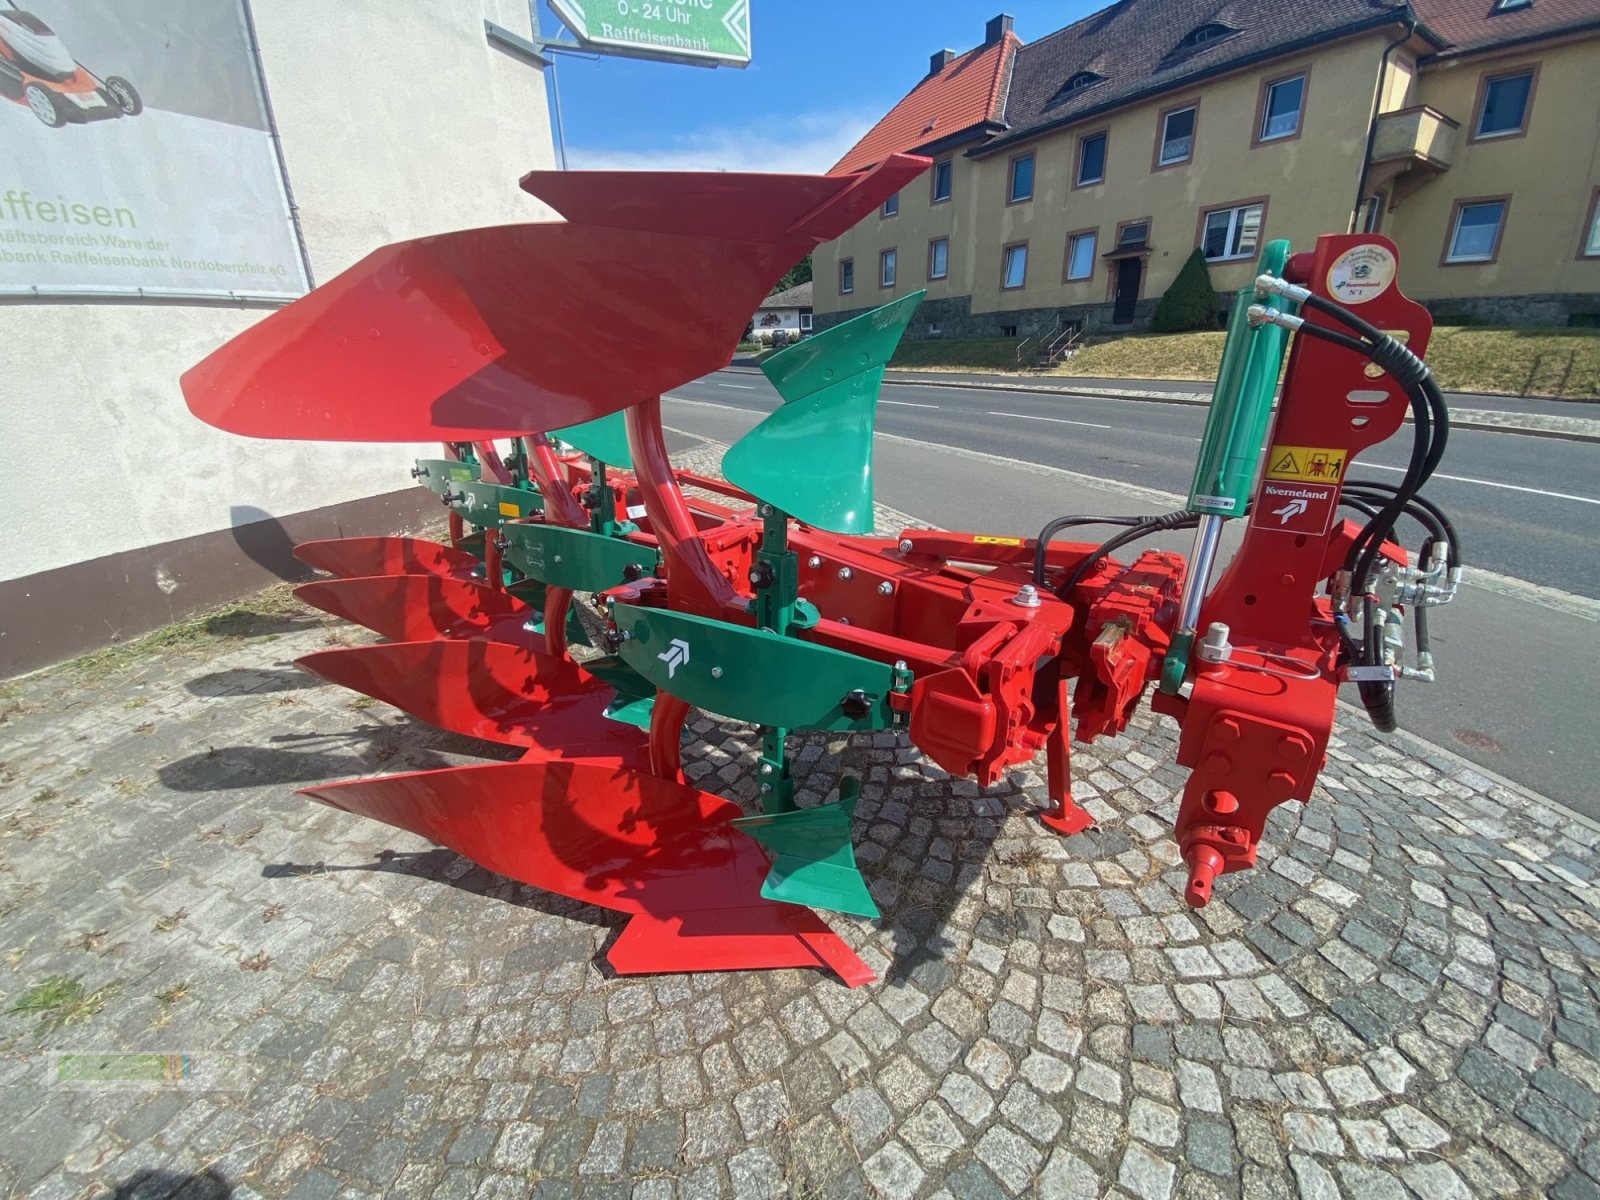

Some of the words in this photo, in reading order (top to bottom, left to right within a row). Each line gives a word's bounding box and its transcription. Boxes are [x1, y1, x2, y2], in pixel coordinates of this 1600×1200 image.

[617, 0, 629, 16] 0
[642, 3, 662, 21] 24
[665, 7, 692, 25] Uhr
[600, 23, 711, 51] Raiffeisenbank
[100, 234, 143, 250] Ware
[145, 239, 171, 251] der
[50, 250, 169, 268] Raiffeisenbank
[171, 257, 267, 275] Nordoberpfalz
[1265, 486, 1328, 500] Kverneland
